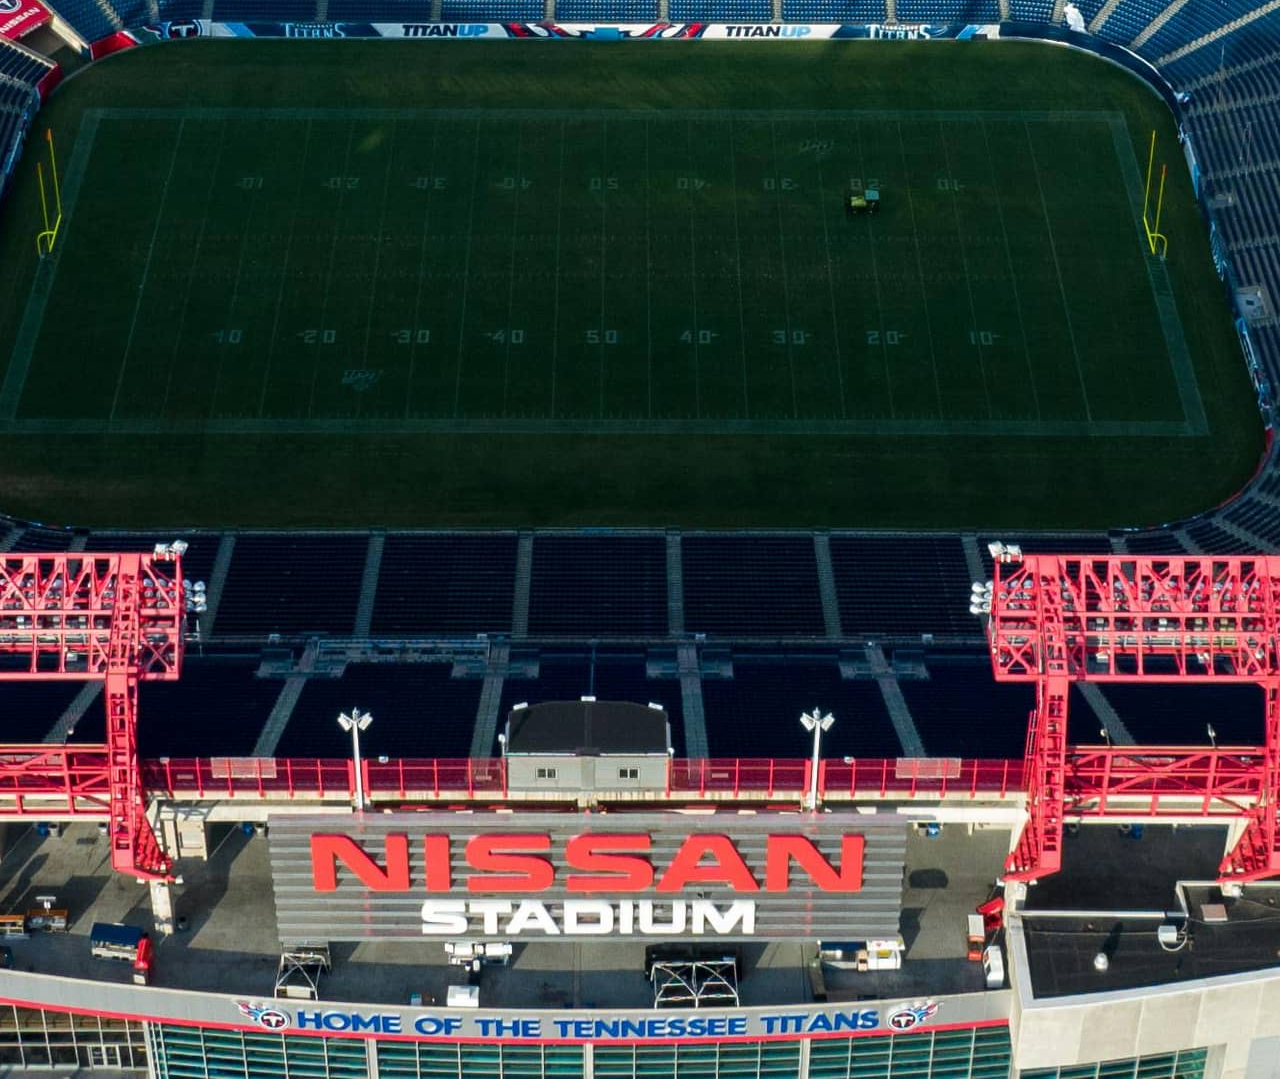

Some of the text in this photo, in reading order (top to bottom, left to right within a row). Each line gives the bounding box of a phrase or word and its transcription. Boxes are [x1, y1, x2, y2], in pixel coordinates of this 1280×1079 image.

[279, 22, 346, 39] TITANS
[867, 24, 933, 41] TITANS
[215, 329, 994, 345] 10 20 30 40 50 40 30 20 10
[311, 834, 864, 893] NISSAN
[420, 900, 756, 936] STADIUM
[296, 1010, 880, 1038] HOME OF THE TENNESSEE TITANS
